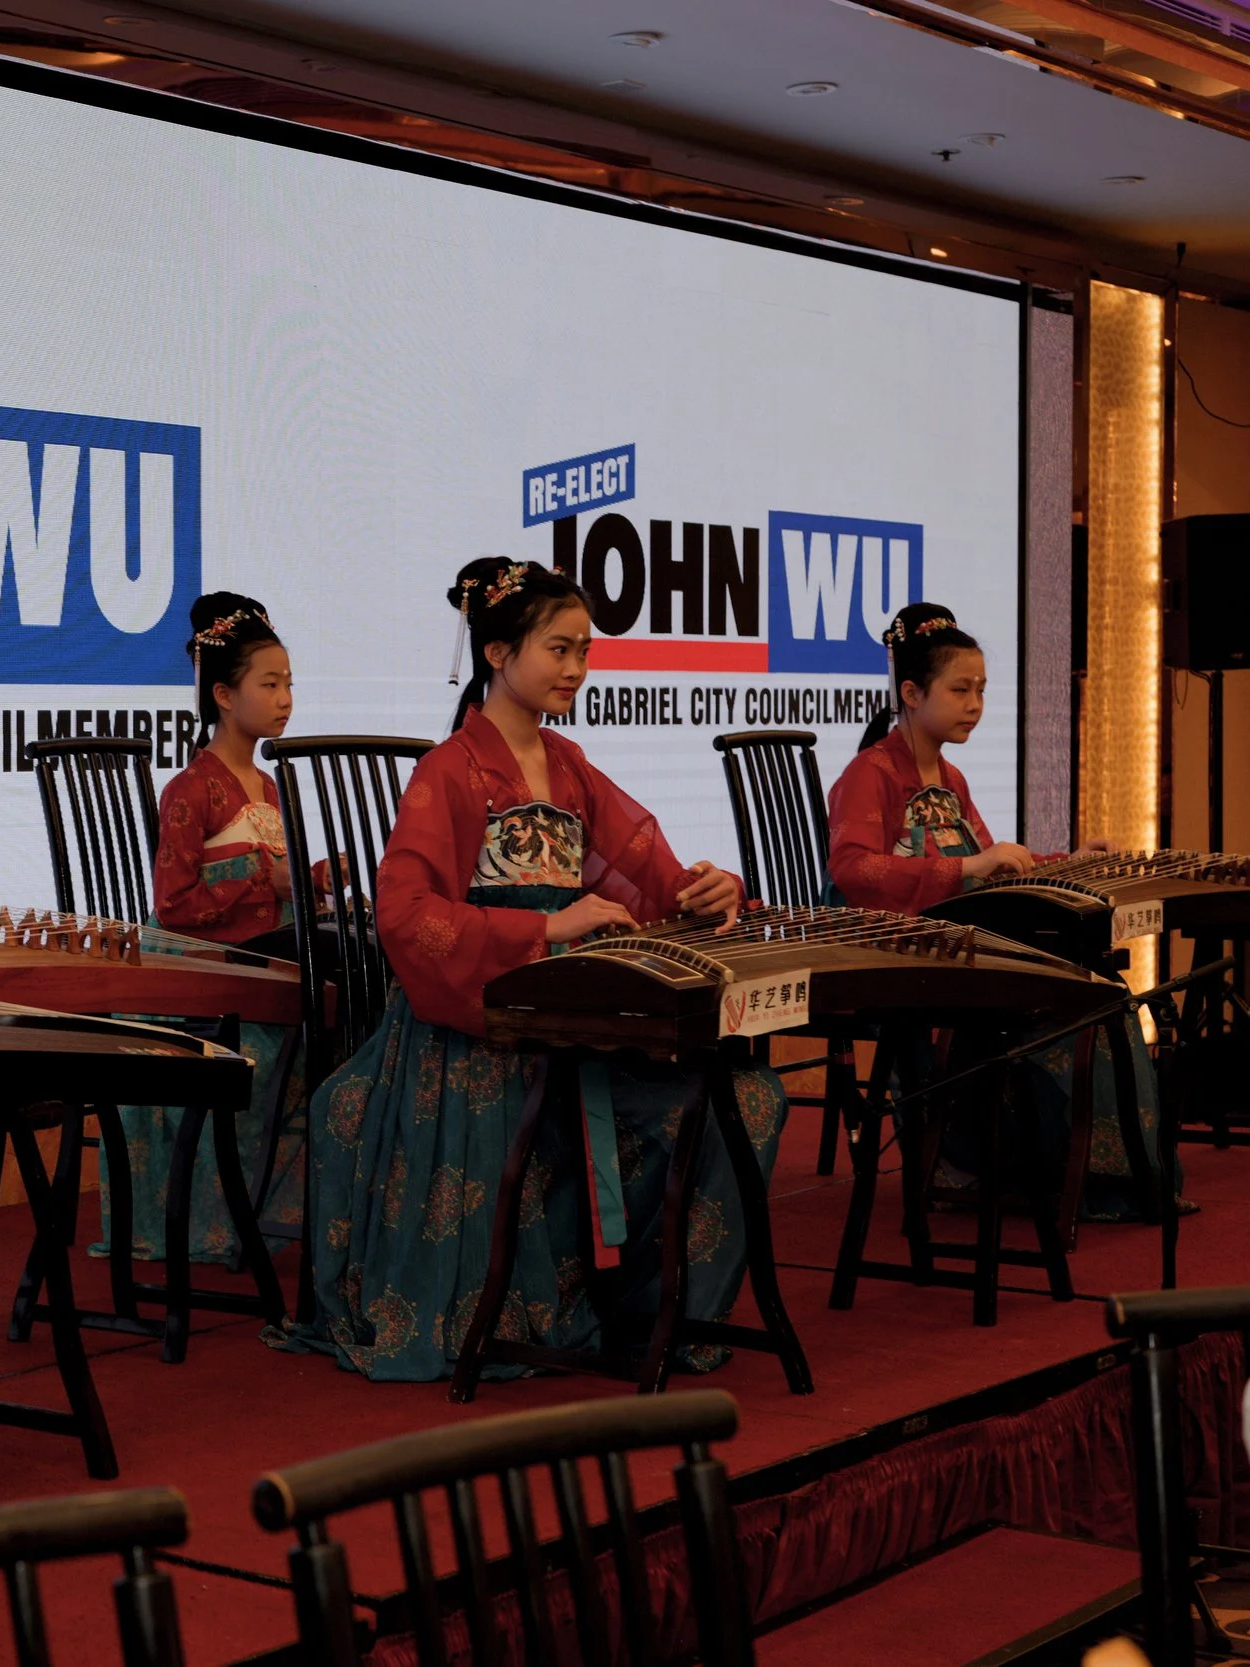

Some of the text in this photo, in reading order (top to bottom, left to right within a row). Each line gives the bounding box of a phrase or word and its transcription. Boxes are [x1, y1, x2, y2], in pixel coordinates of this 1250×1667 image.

[528, 454, 630, 517] RE-ELECT
[781, 528, 910, 647] WU
[586, 686, 682, 727] GABRIEL
[690, 686, 737, 726] CITY
[744, 687, 890, 725] COUNCILMEM
